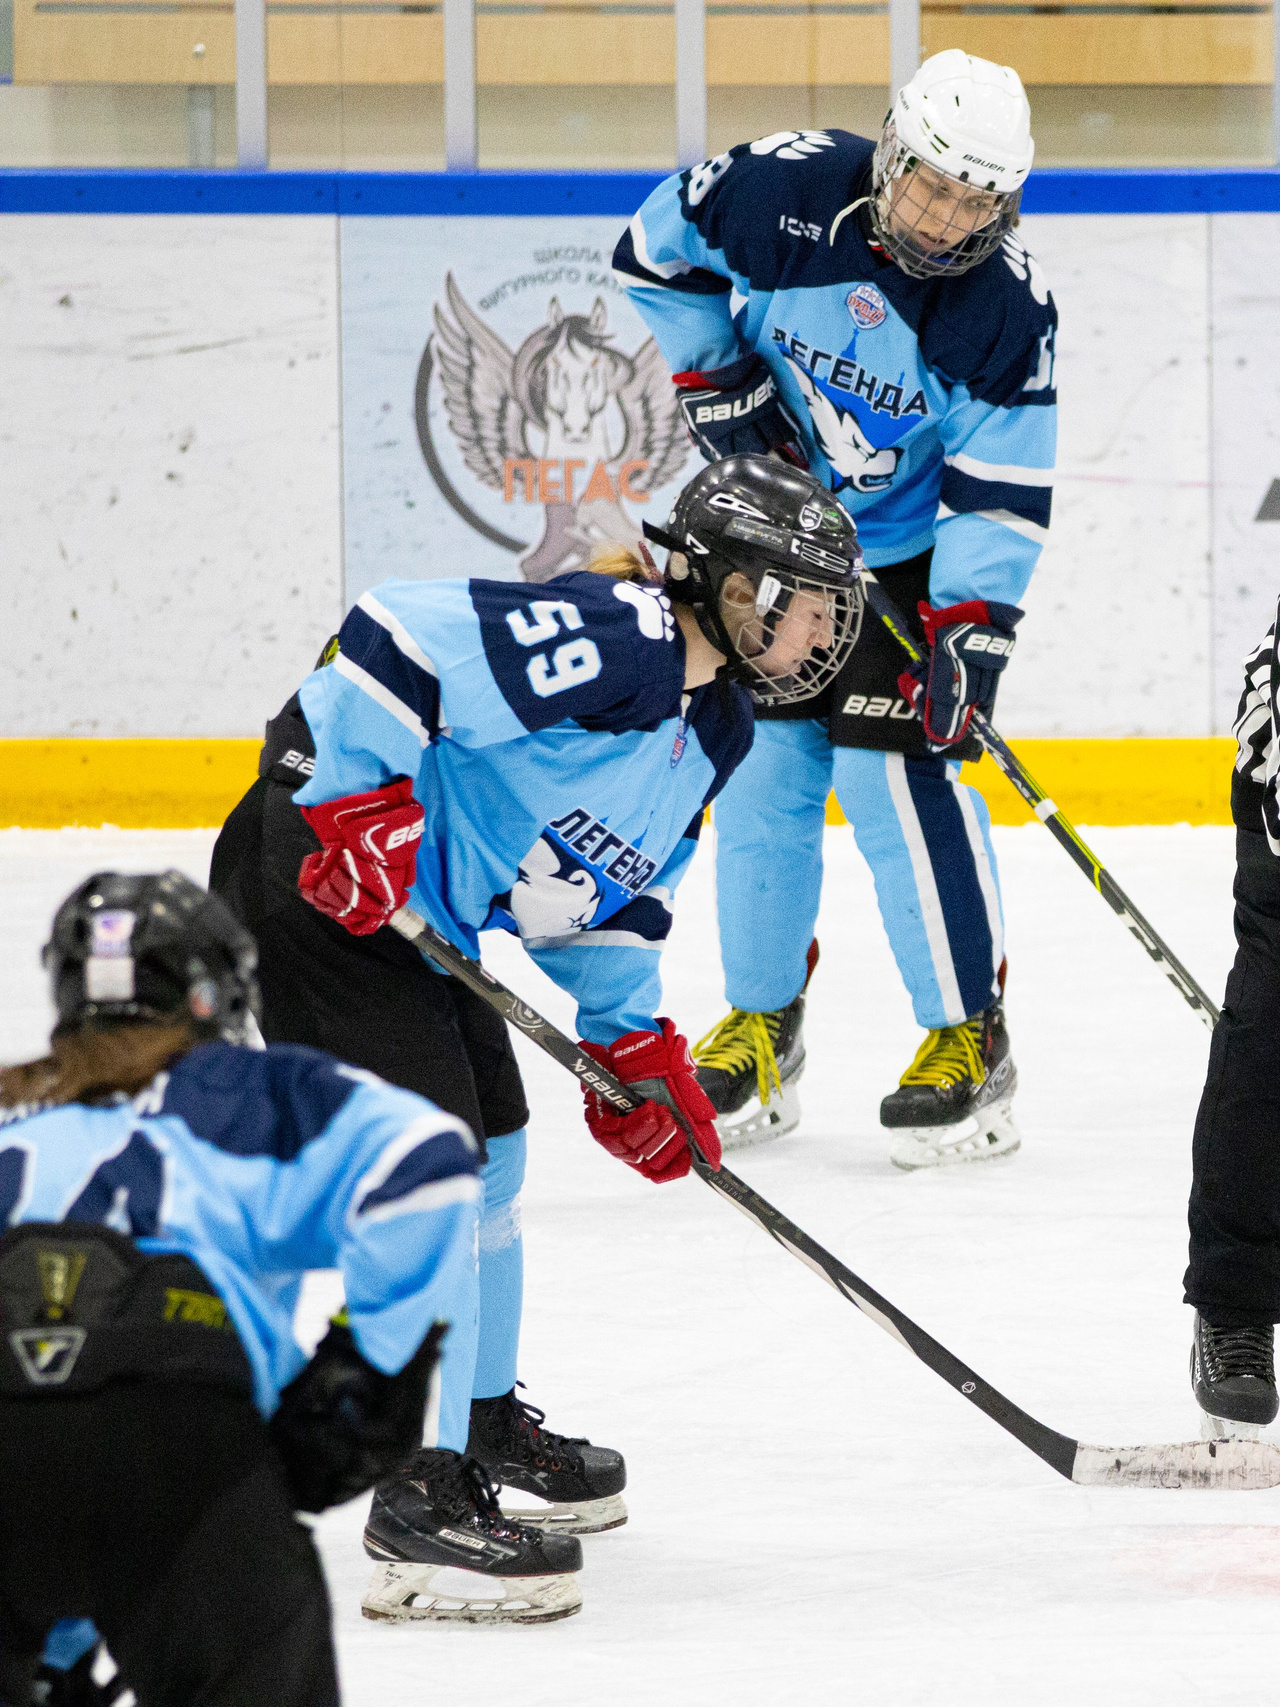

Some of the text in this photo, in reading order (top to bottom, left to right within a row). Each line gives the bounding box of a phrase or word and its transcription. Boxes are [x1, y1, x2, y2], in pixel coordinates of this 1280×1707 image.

[963, 154, 1006, 173] BAUER
[771, 326, 929, 419] ЛЕГЕНДА
[695, 374, 777, 424] BAUER
[503, 458, 650, 503] ПЕГАС
[505, 600, 603, 699] 59
[614, 1035, 656, 1058] BAUER
[443, 1529, 483, 1547] BAUER
